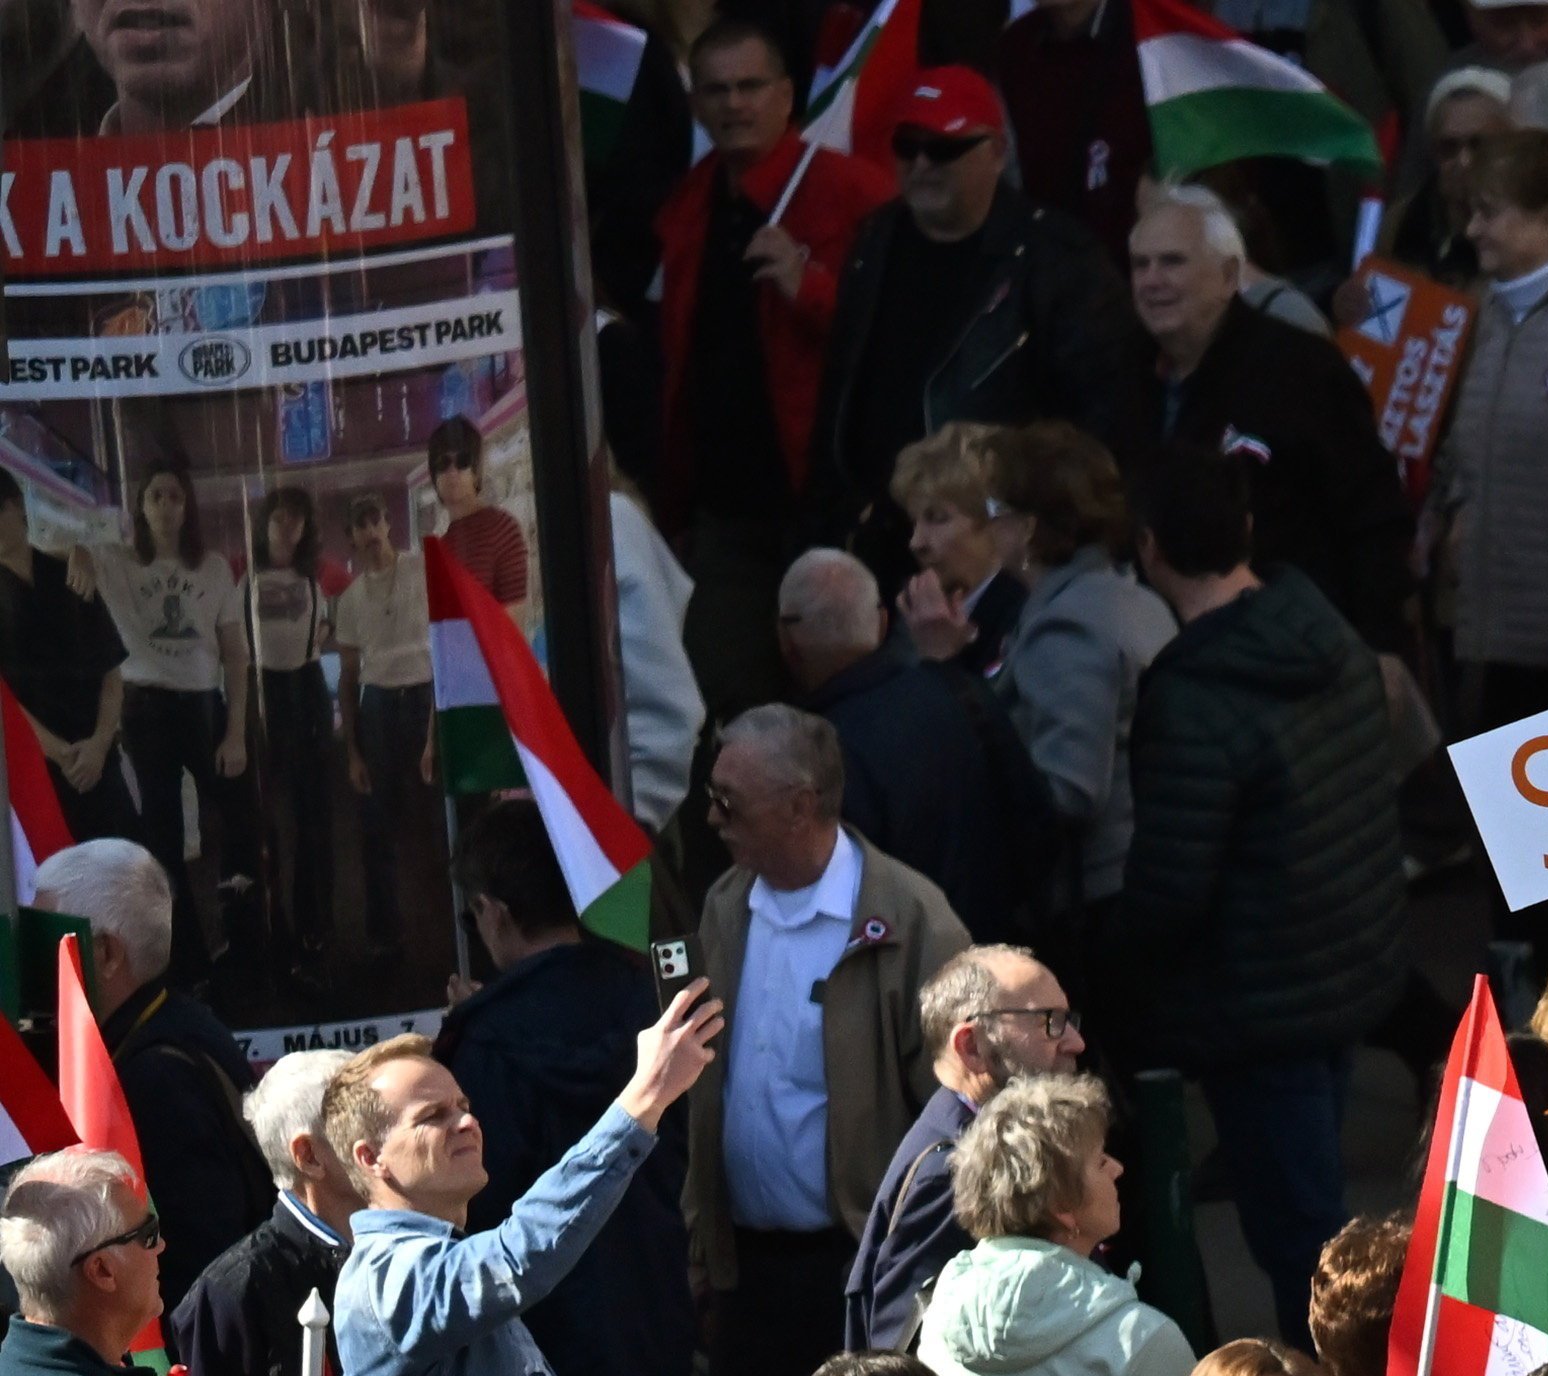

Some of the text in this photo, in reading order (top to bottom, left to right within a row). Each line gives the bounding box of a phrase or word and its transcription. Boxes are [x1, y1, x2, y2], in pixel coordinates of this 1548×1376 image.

[46, 171, 87, 257] A
[106, 129, 455, 255] KOCKÁZAT
[271, 310, 504, 367] BUDAPEST PARK
[73, 353, 158, 382] PARK
[283, 1026, 379, 1053] MÁJUS
